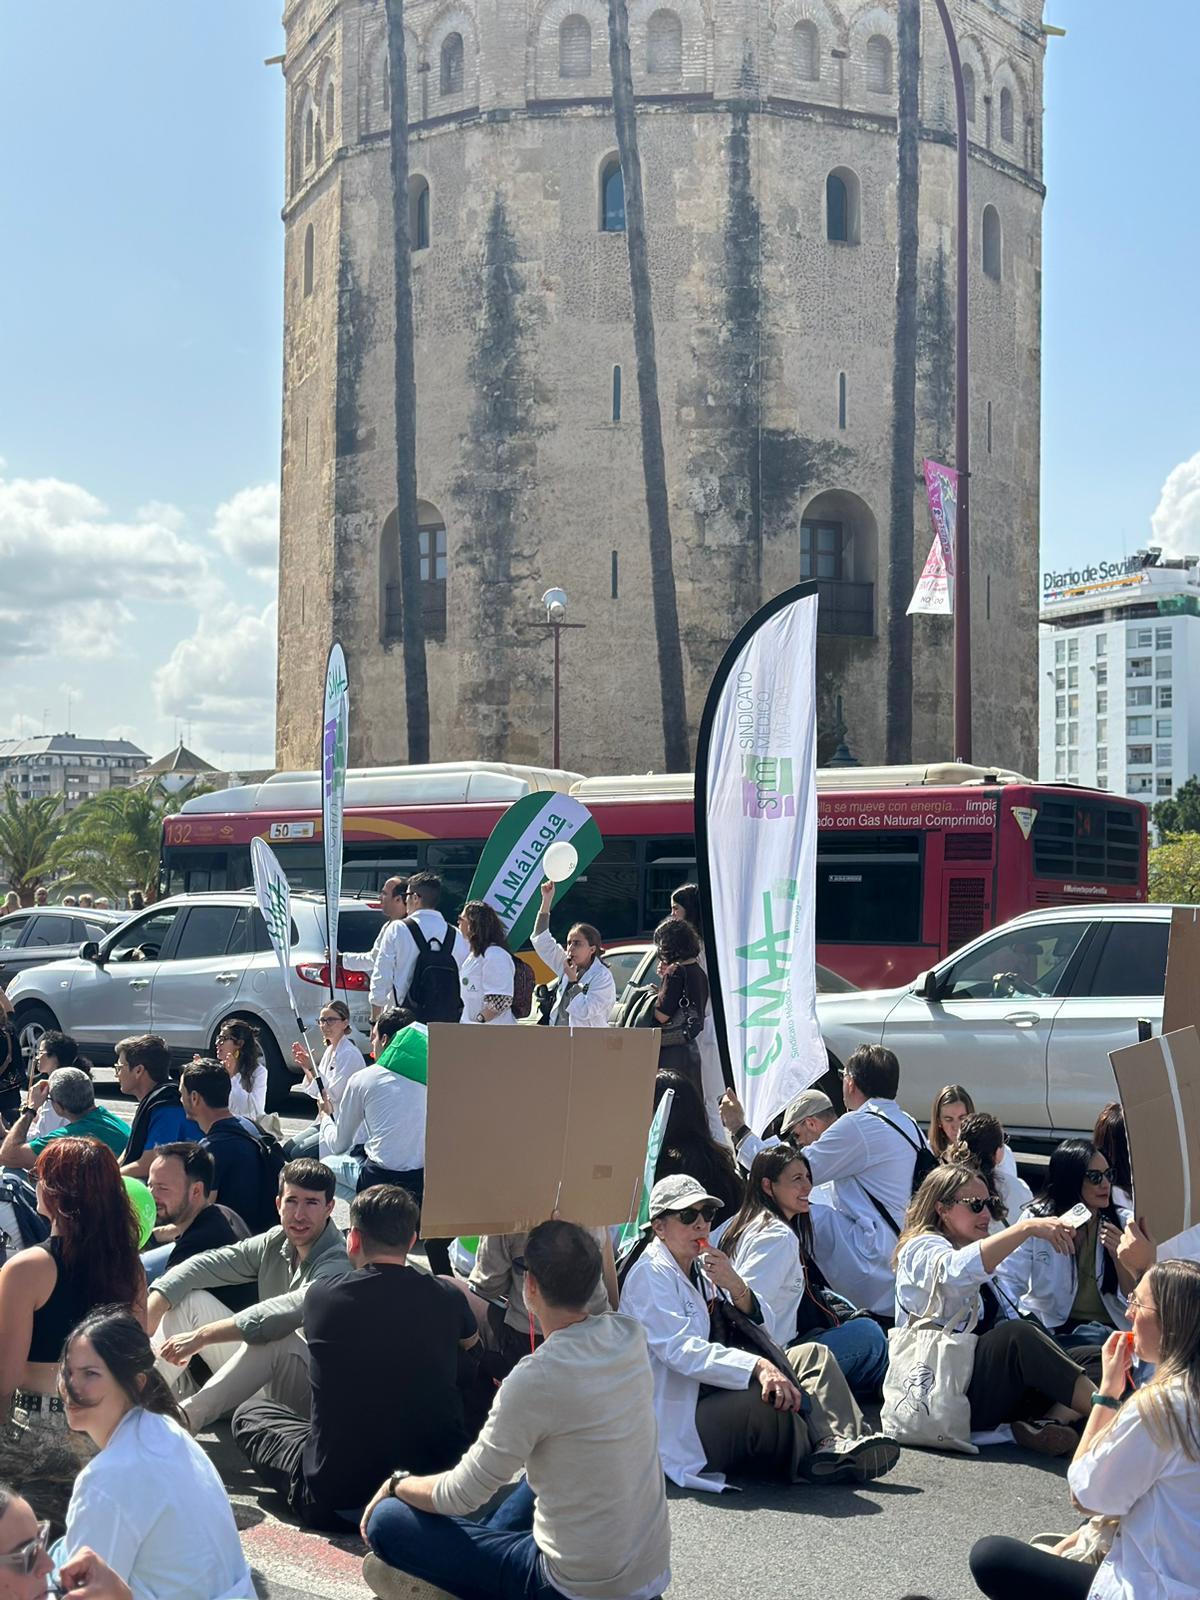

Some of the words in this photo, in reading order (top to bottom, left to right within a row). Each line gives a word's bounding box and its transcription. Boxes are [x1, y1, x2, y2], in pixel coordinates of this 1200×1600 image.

[1043, 567, 1080, 590] Diario
[1082, 564, 1098, 583] de
[737, 671, 754, 749] SINDICATO
[756, 762, 777, 810] smm
[817, 815, 834, 827] ado
[837, 817, 856, 826] con
[859, 814, 880, 826] Gas
[884, 814, 922, 826] Natural
[818, 802, 832, 813] lla
[834, 803, 847, 813] se
[849, 802, 886, 813] mueve
[888, 802, 908, 812] con
[166, 824, 192, 843] 132
[274, 823, 289, 837] 50
[503, 813, 562, 891] Málaga
[785, 1019, 800, 1058] Sindicato
